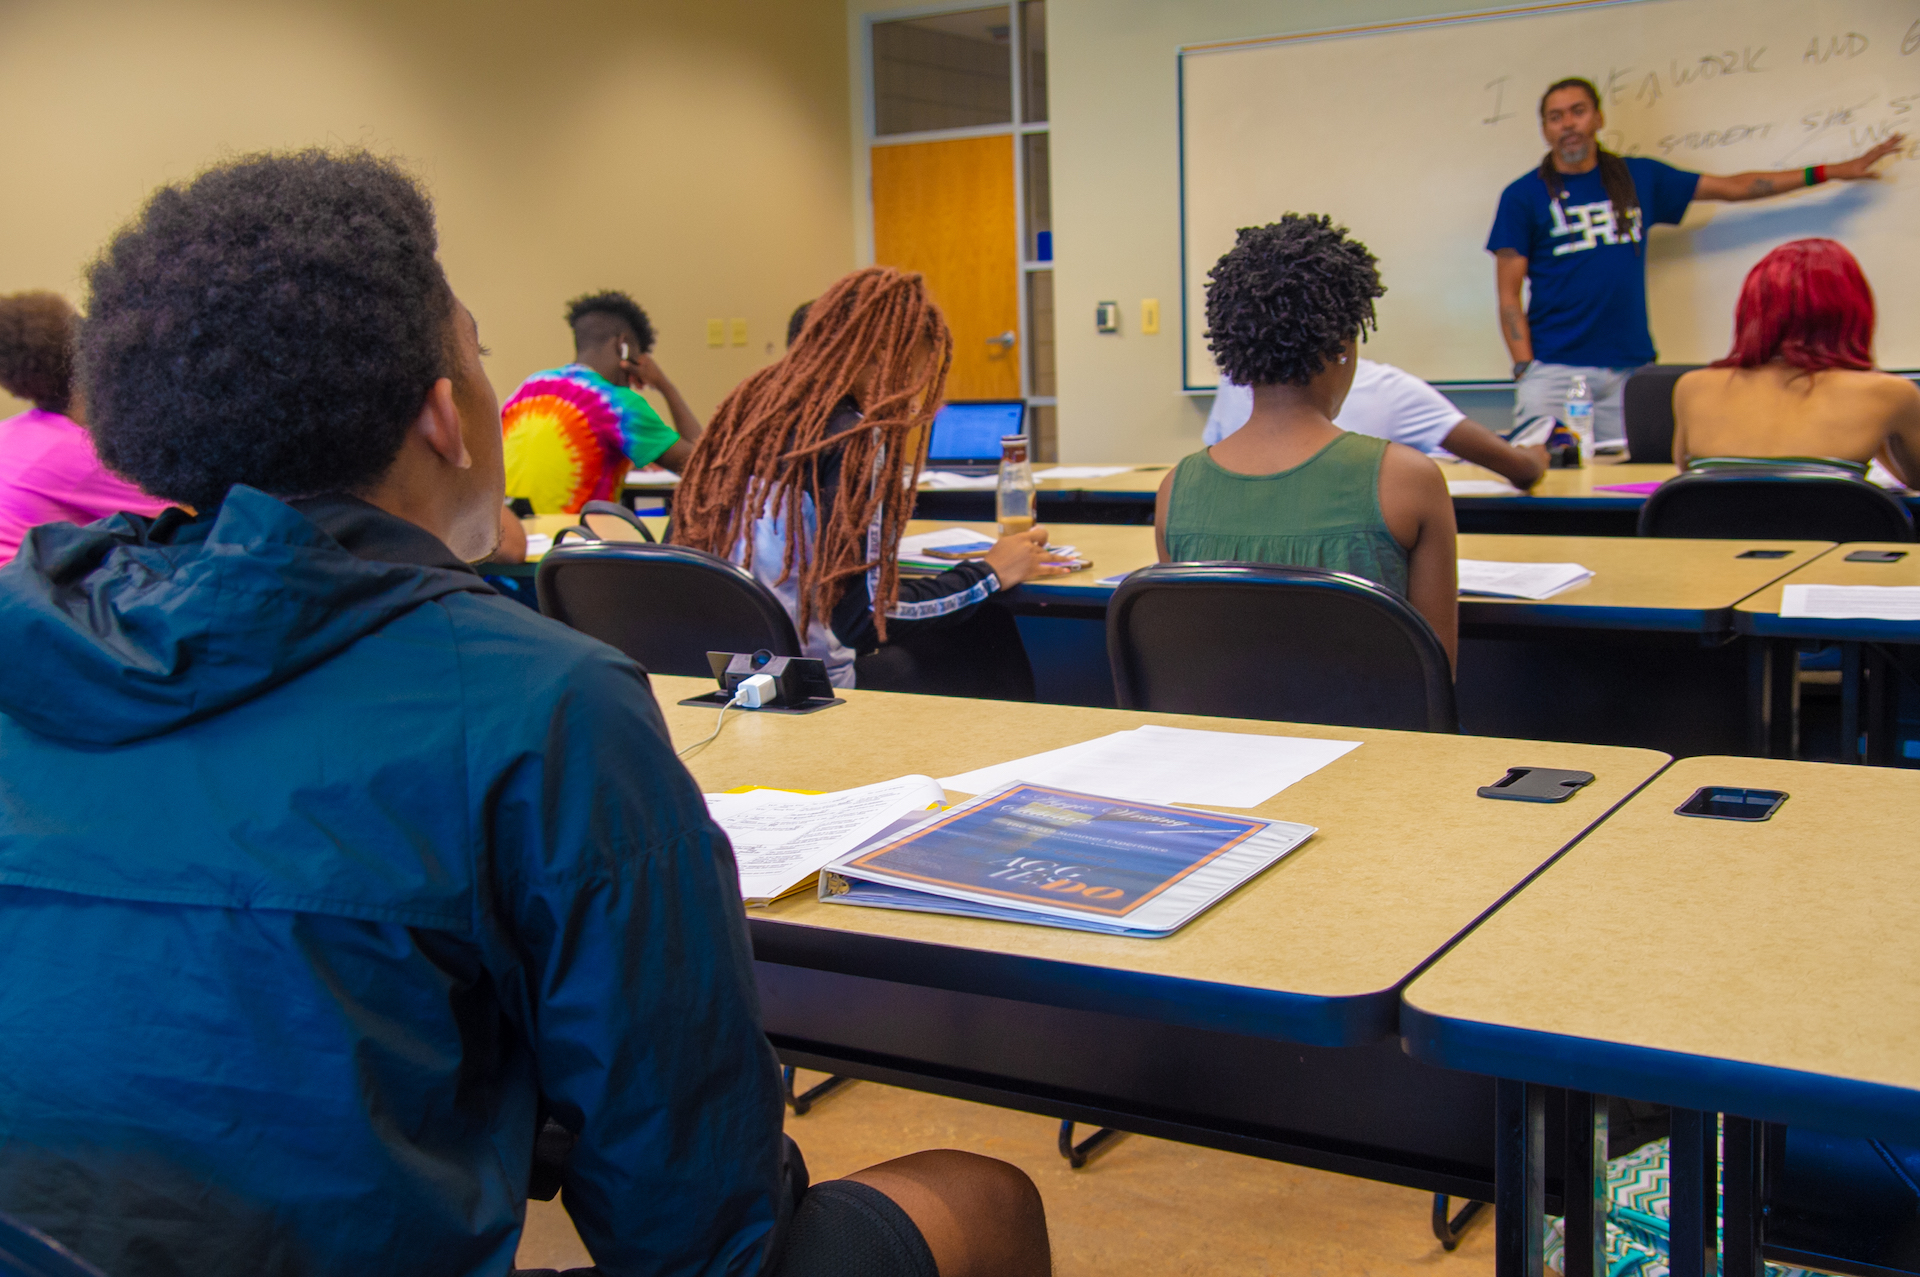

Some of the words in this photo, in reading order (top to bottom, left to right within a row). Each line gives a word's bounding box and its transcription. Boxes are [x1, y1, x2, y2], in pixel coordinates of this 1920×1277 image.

[1669, 44, 1772, 88] WORK
[1802, 32, 1870, 65] AND
[1059, 829, 1105, 844] Summer
[1106, 837, 1169, 853] Experience
[1039, 878, 1125, 900] DO
